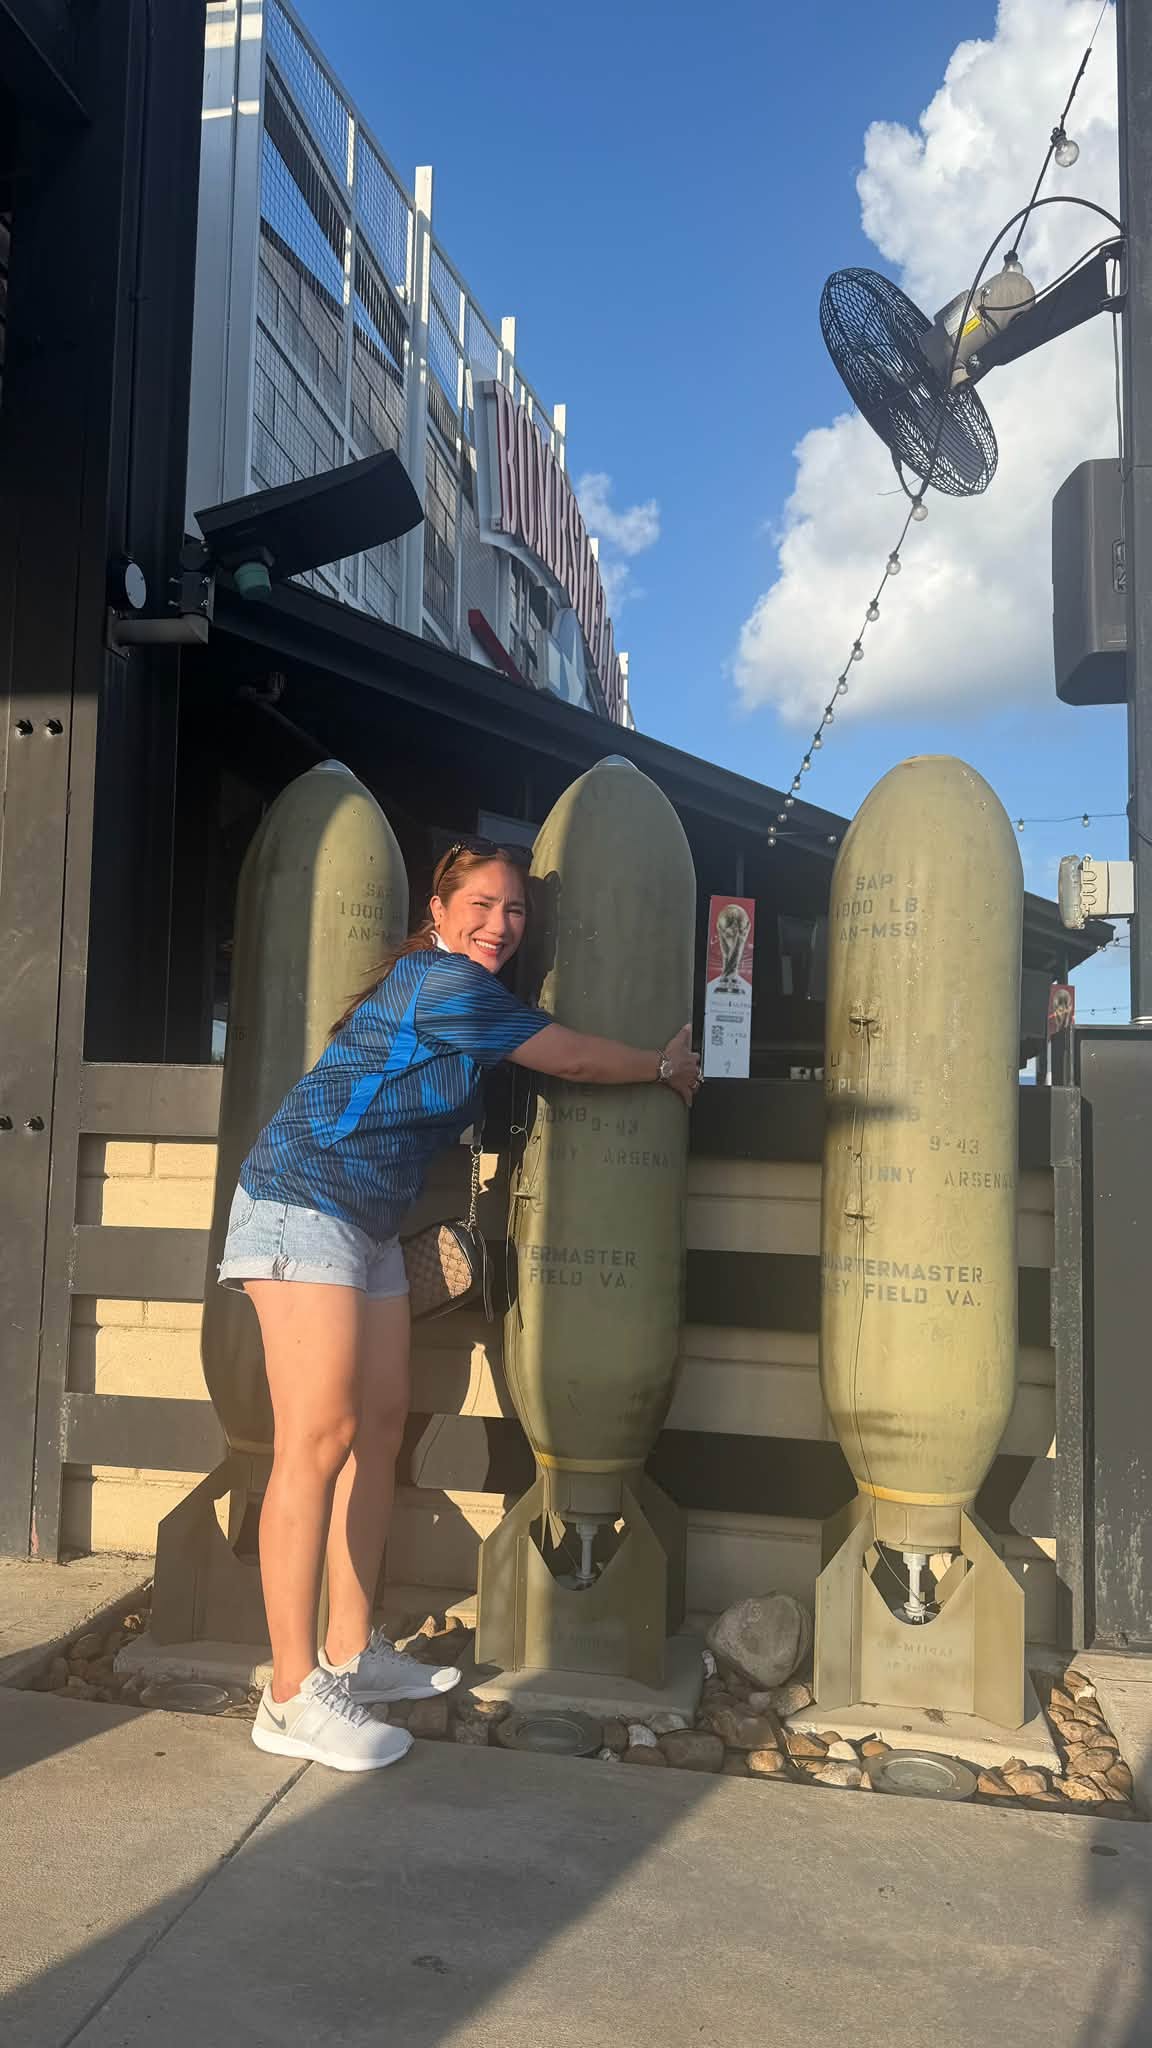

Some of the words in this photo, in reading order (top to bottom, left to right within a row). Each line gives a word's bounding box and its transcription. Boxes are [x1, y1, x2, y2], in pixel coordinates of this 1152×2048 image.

[856, 873, 894, 891] SAP
[338, 902, 383, 921] 1000
[889, 897, 925, 913] LB.
[929, 1135, 979, 1154] 9-43
[530, 1268, 584, 1287] FIELD
[865, 1282, 928, 1304] FIELD
[946, 1289, 982, 1307] VA.
